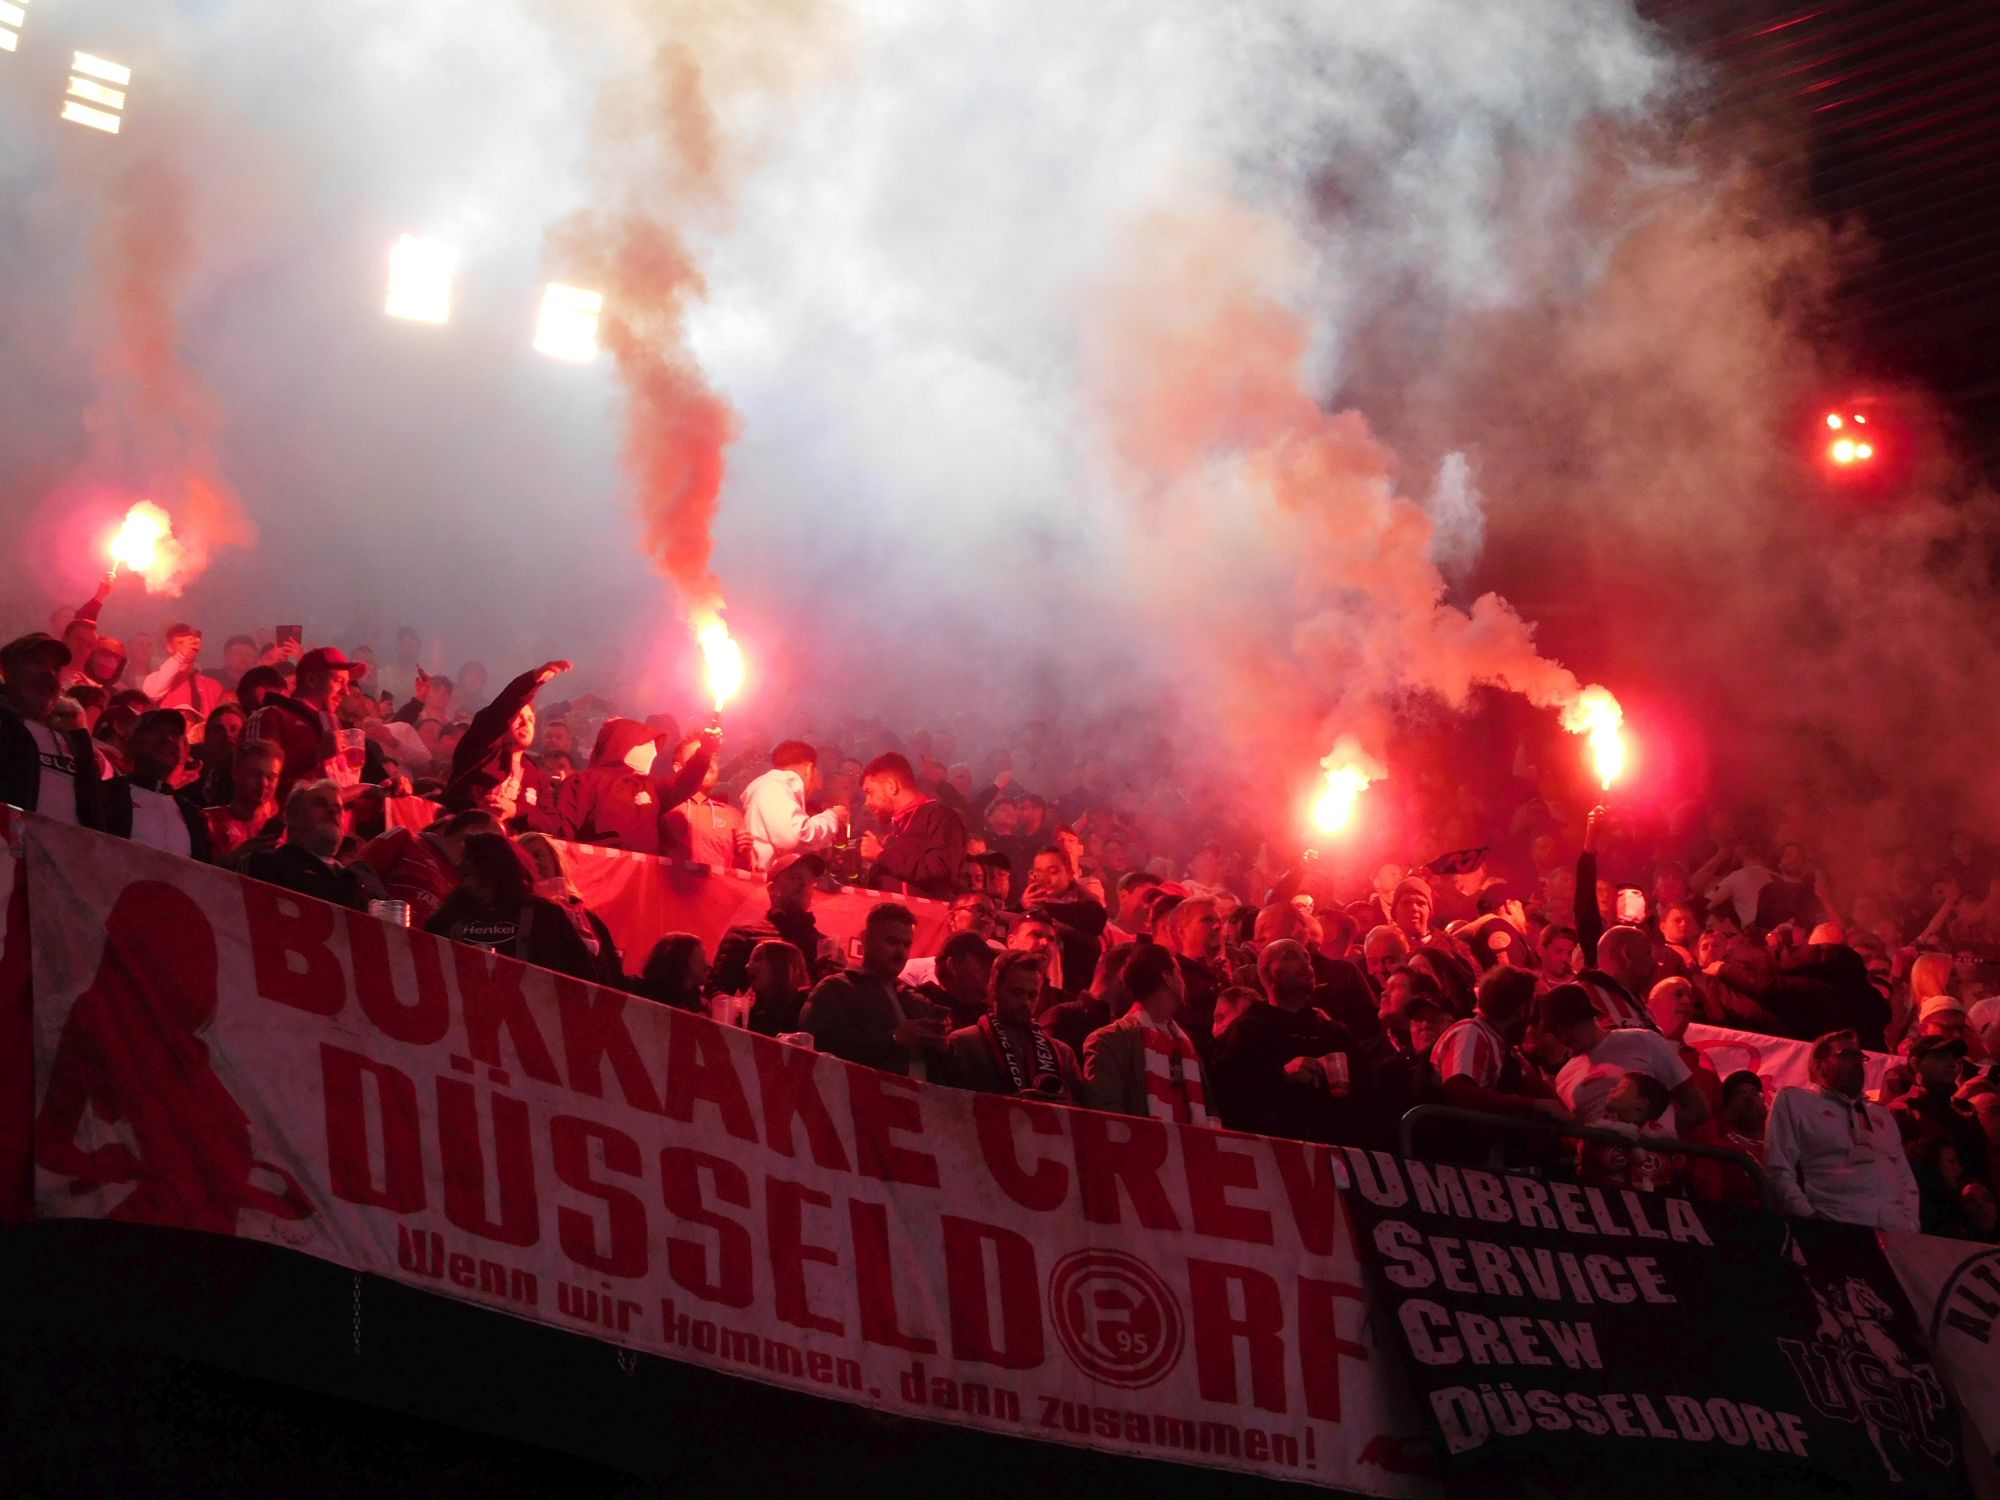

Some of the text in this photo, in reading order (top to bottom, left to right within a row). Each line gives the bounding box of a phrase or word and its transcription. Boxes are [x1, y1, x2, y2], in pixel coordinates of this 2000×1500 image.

[462, 923, 516, 937] Henkel
[240, 875, 941, 1188] BUKKAKE
[1348, 1147, 1712, 1246] UMBRELLA
[1372, 1219, 1677, 1304] SERVICE
[399, 1222, 538, 1307] Wenn
[558, 1281, 642, 1333] wir
[901, 1362, 1020, 1423] dann
[1039, 1396, 1316, 1469] zusammen!
[1115, 1328, 1150, 1356] 95
[1398, 1298, 1603, 1370] CREW
[1428, 1382, 1809, 1458] DÜSSELDORF
